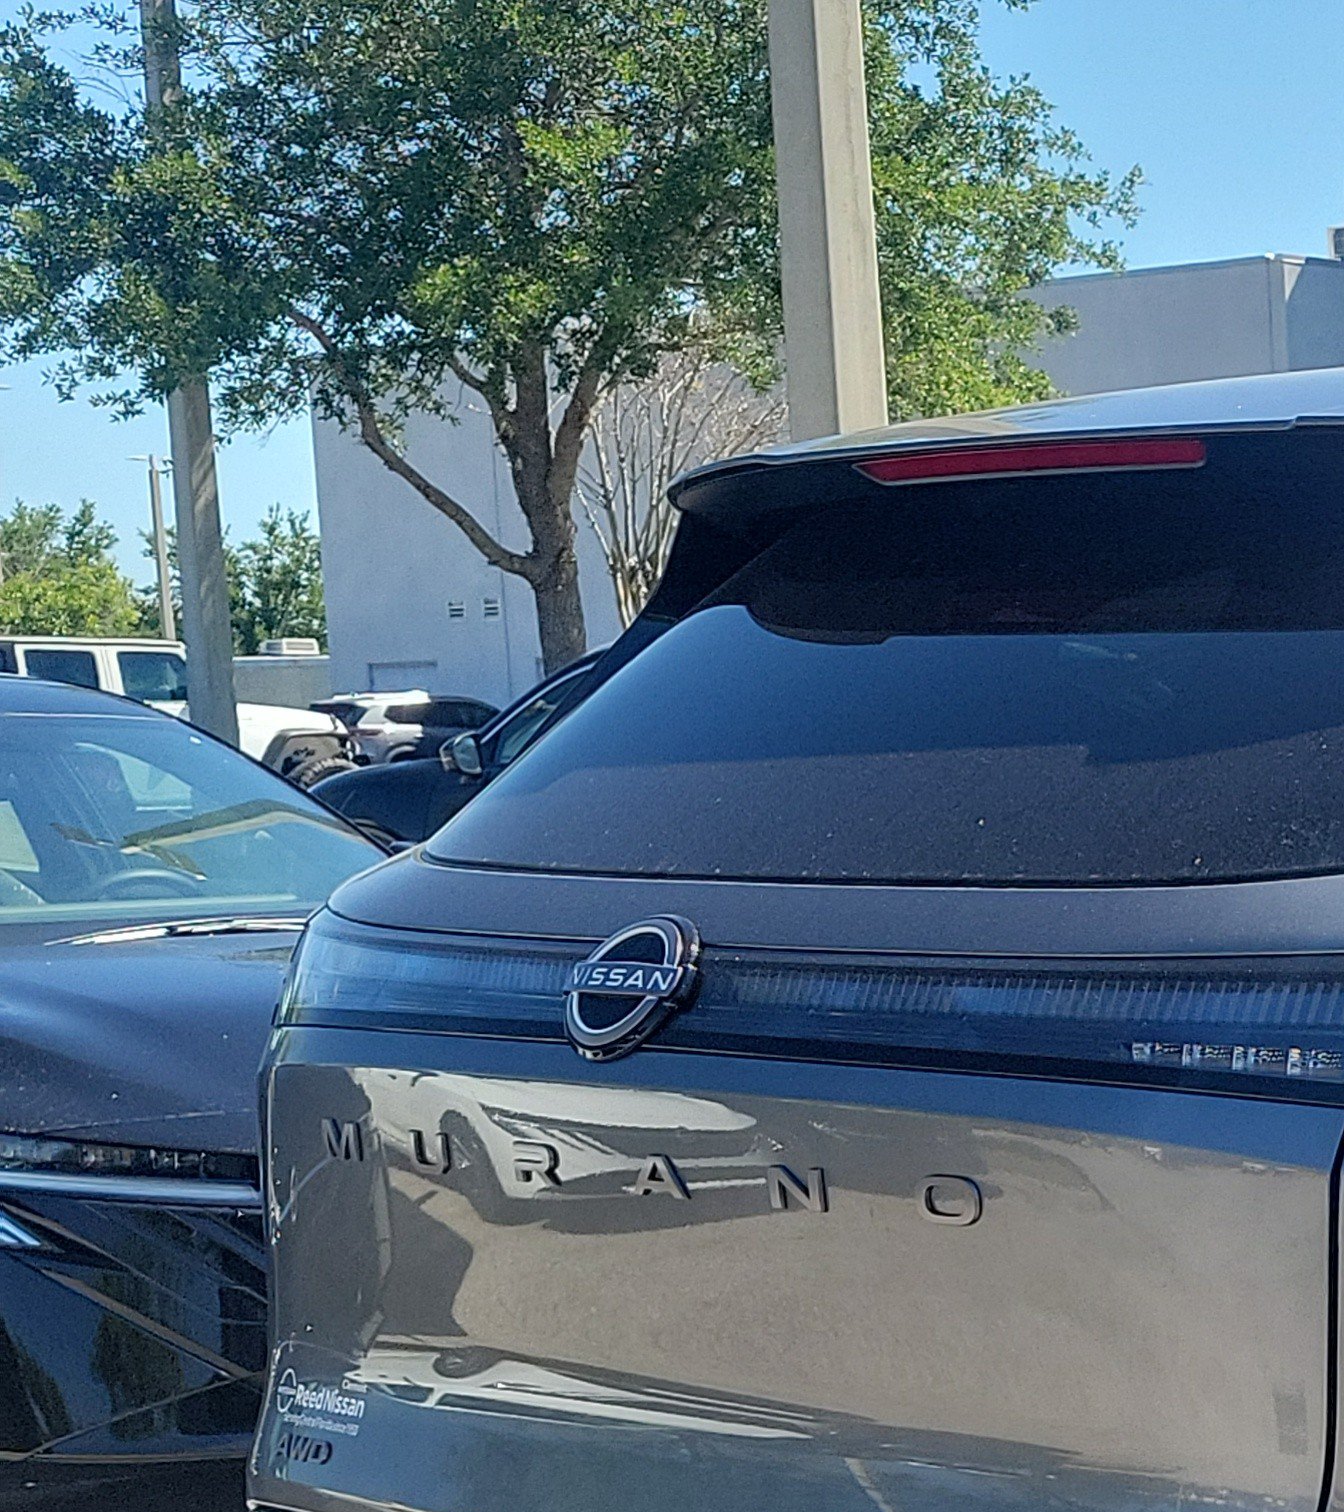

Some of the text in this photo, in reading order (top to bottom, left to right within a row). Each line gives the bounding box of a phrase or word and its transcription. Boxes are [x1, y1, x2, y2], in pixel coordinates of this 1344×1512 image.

[572, 967, 674, 991] NISSAN
[321, 1117, 984, 1227] MURANO
[294, 1384, 325, 1411] Reed
[322, 1387, 366, 1419] Nissan
[276, 1432, 334, 1466] AWD
